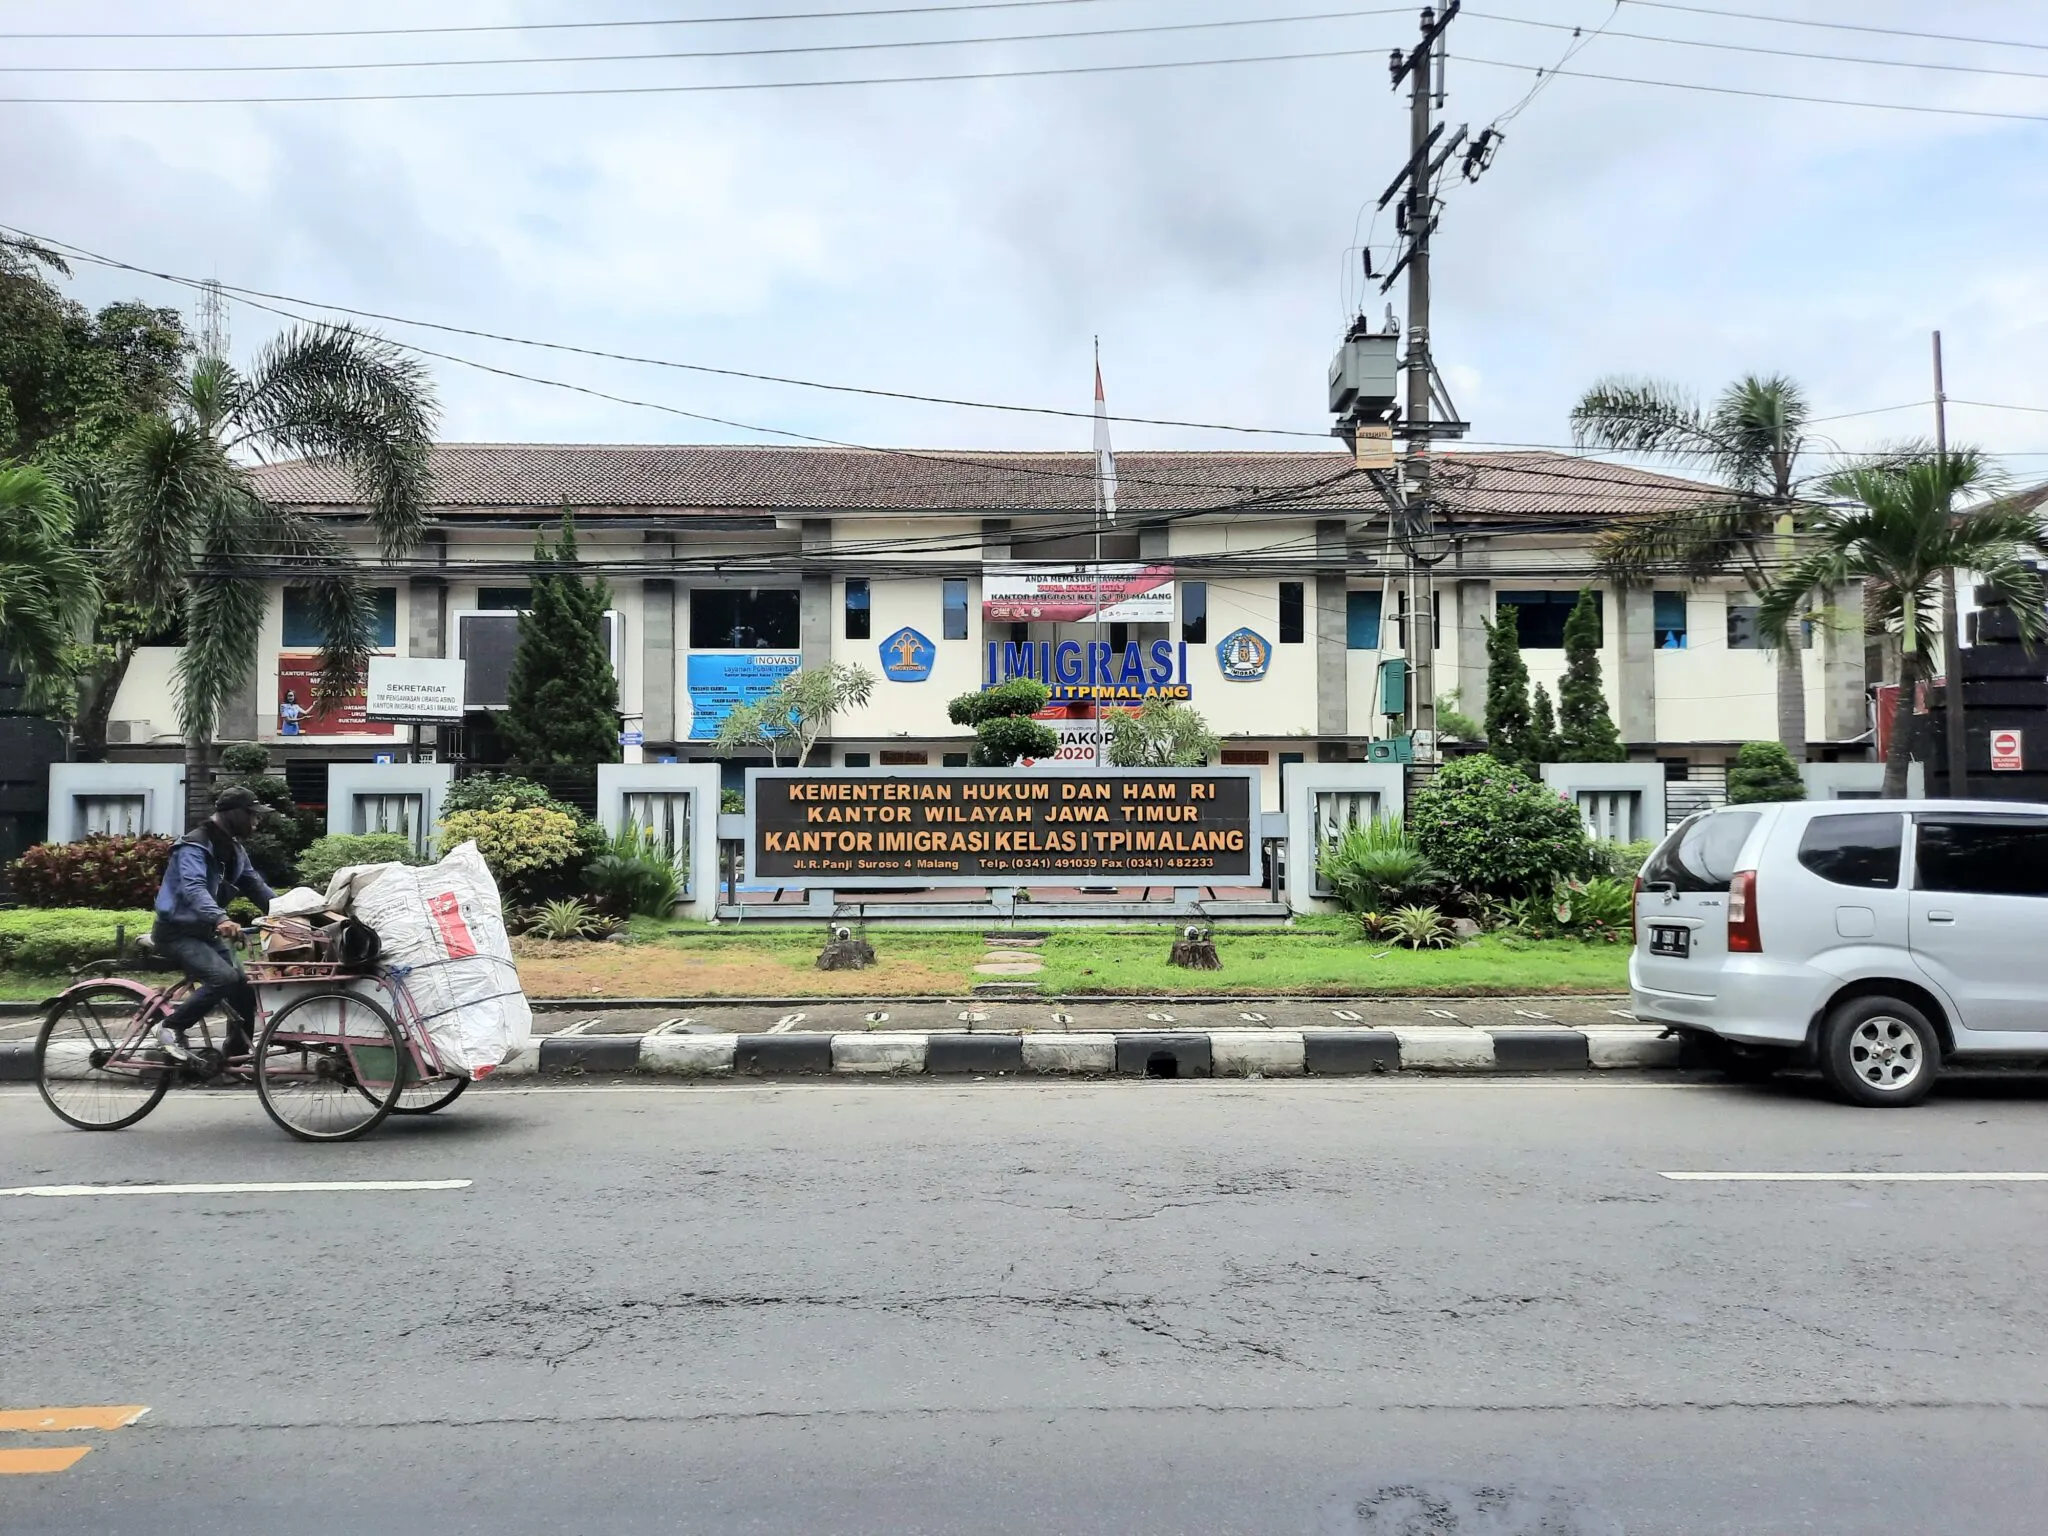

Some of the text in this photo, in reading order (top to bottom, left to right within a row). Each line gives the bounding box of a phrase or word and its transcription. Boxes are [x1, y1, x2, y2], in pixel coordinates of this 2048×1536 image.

[755, 656, 798, 665] INOVASI
[987, 640, 1187, 685] IMIGRASI
[386, 684, 446, 692] SEKRETARIAT
[1054, 747, 1095, 760] 2020
[789, 783, 1215, 800] KEMENTERIAN HUKUM DAN HAM RI
[807, 806, 1198, 823] KANTOR WILAYAH JAWA TIMUR
[765, 831, 872, 852] KANTOR
[878, 831, 989, 852] IMIGRASI
[858, 859, 900, 869] Suroso
[904, 859, 912, 868] 4
[917, 859, 959, 870] Malang
[979, 859, 1008, 869] Telp.
[1011, 858, 1050, 869] (0341)
[1055, 858, 1097, 868] 491039
[1101, 858, 1122, 868] Fax
[1126, 858, 1164, 869] (0341)
[1167, 858, 1214, 868] 482233
